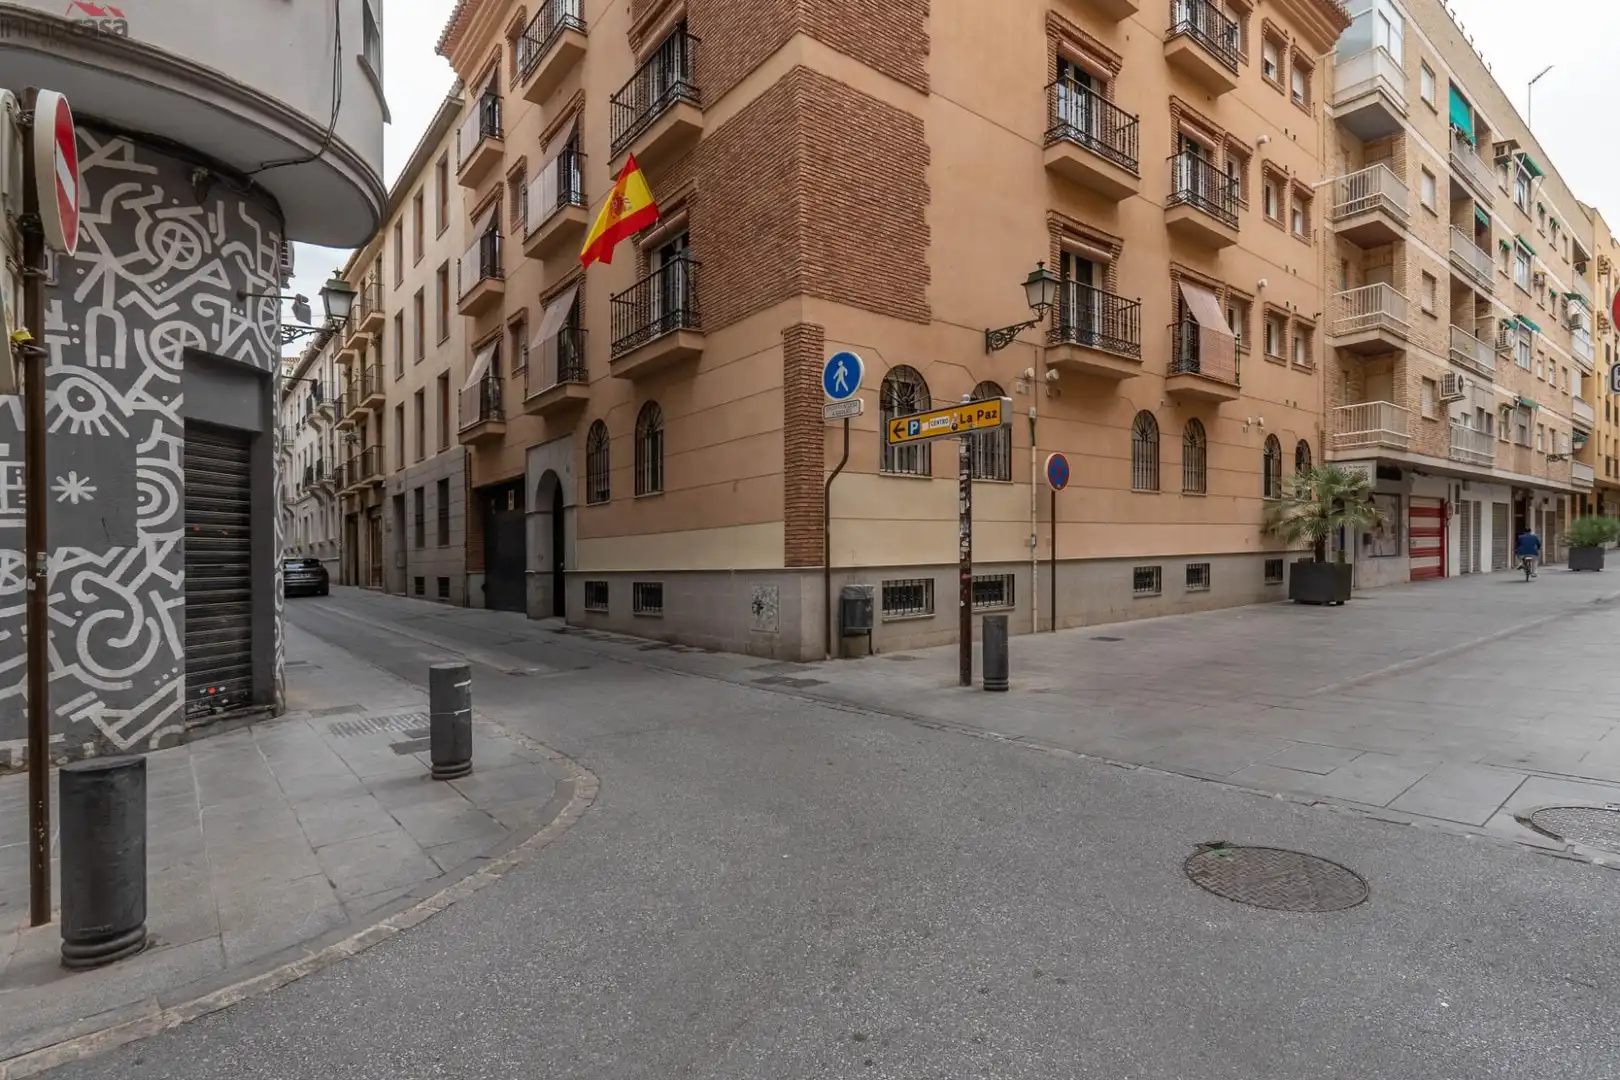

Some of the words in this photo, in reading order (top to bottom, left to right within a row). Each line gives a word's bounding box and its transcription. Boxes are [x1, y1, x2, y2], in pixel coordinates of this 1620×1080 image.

[910, 420, 919, 435] P
[930, 417, 949, 427] CENTRO
[960, 413, 973, 424] La
[977, 410, 997, 420] Paz
